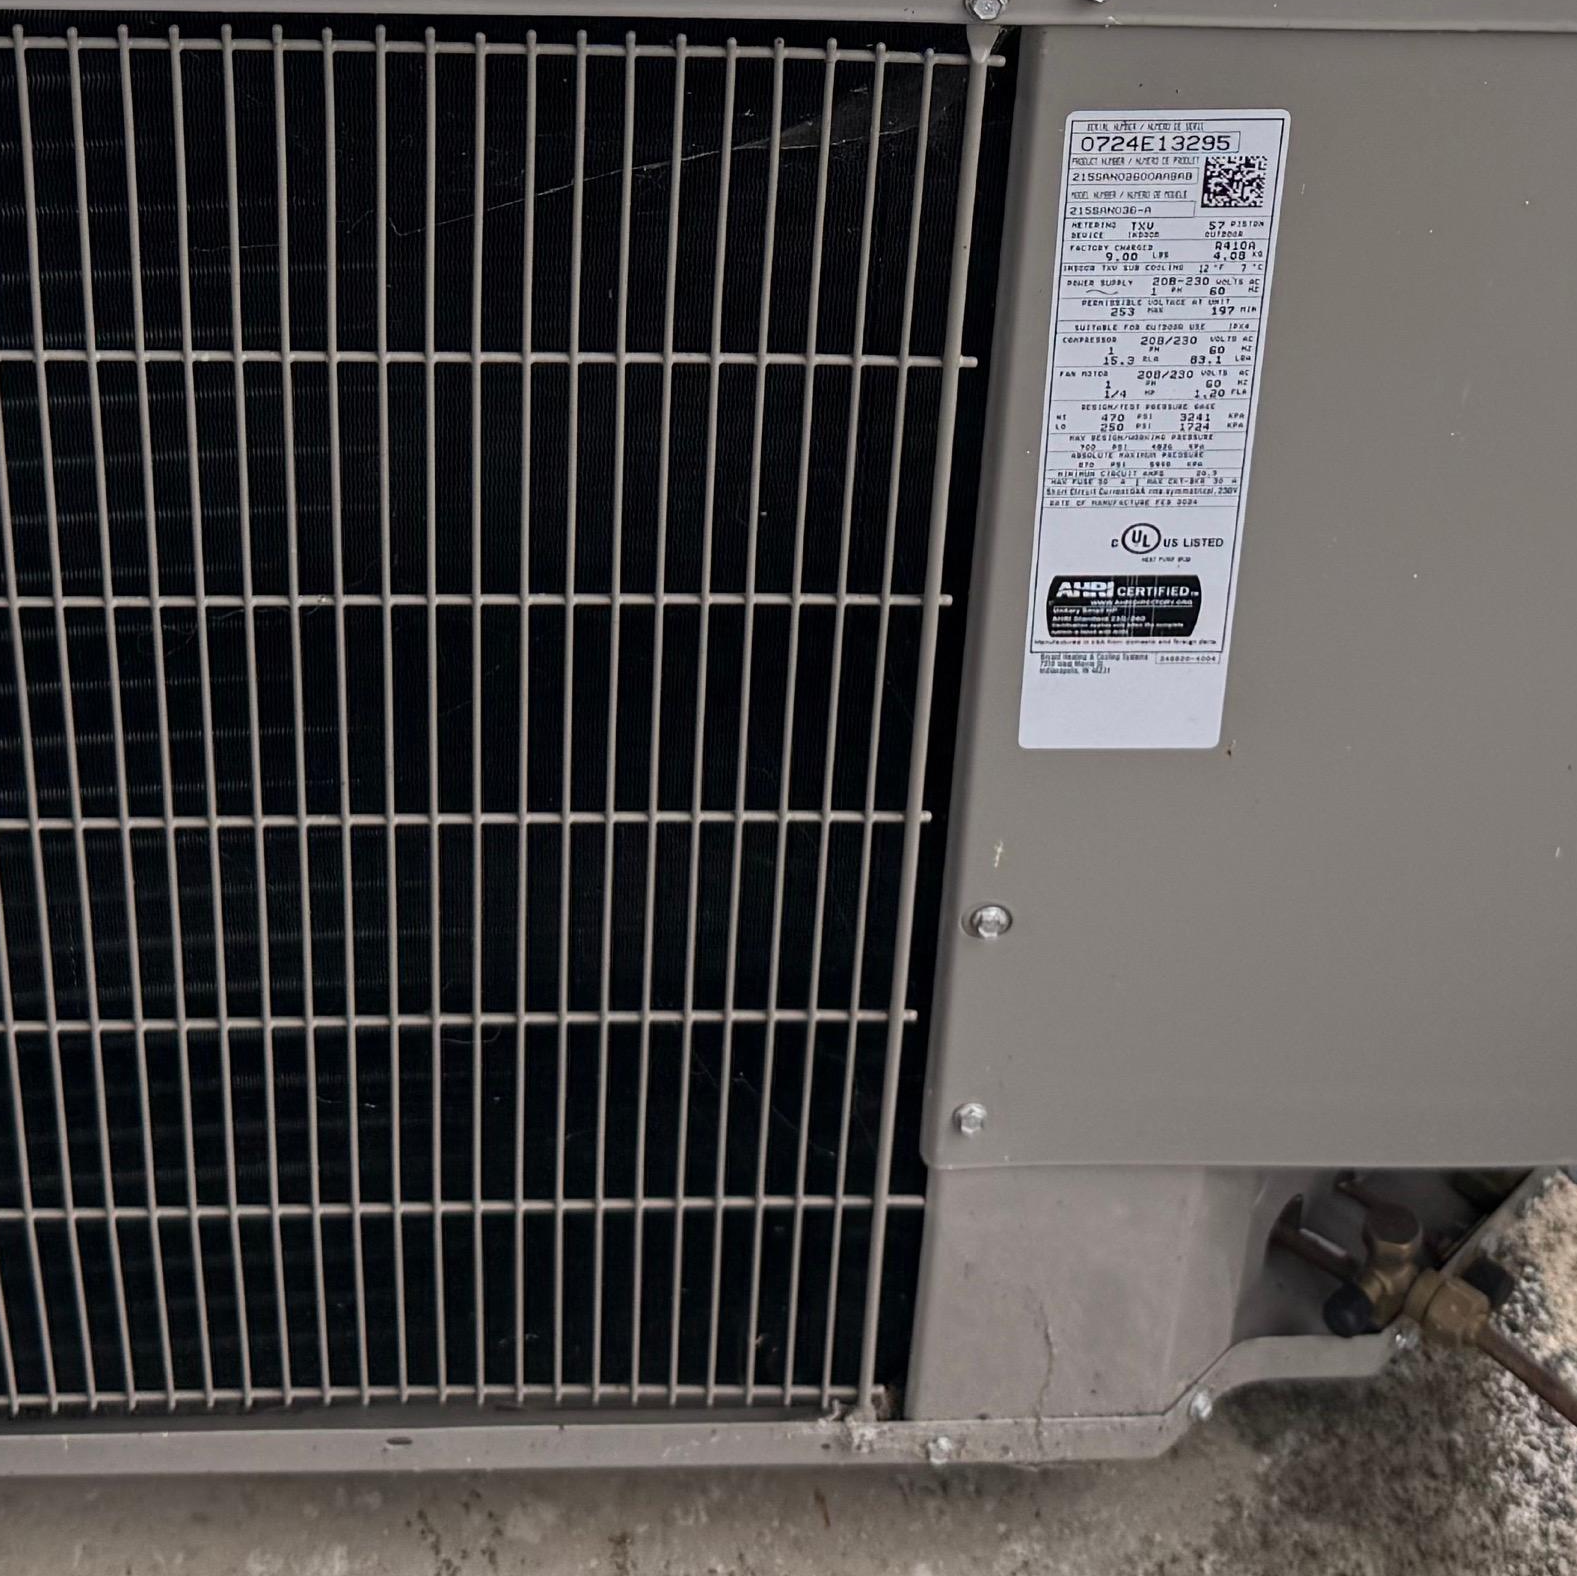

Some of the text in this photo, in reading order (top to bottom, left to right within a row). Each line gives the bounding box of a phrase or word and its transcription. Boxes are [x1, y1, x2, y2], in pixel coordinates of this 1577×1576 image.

[1081, 135, 1231, 153] 0724E13295
[1208, 221, 1225, 230] 57
[1071, 231, 1104, 239] DEVICE
[1215, 241, 1256, 250] R410A
[1106, 252, 1138, 262] 9.00
[1213, 251, 1246, 261] 4.08
[1152, 277, 1210, 286] 208-230
[1209, 286, 1225, 295] 60
[1110, 307, 1135, 317] 253
[1211, 306, 1235, 316] 197
[1062, 336, 1117, 344] COMPRESSOR
[1140, 336, 1198, 346] 208/230
[1209, 346, 1226, 355] 60
[1102, 356, 1135, 366] 15.3
[1137, 370, 1194, 380] 208/230
[1205, 379, 1222, 389] 60
[1100, 413, 1125, 422] 470
[1179, 413, 1211, 422] 3241
[1100, 423, 1124, 432] 250
[1163, 538, 1178, 547] US
[1183, 537, 1224, 548] LISTED
[1117, 586, 1189, 597] CERTIFIED
